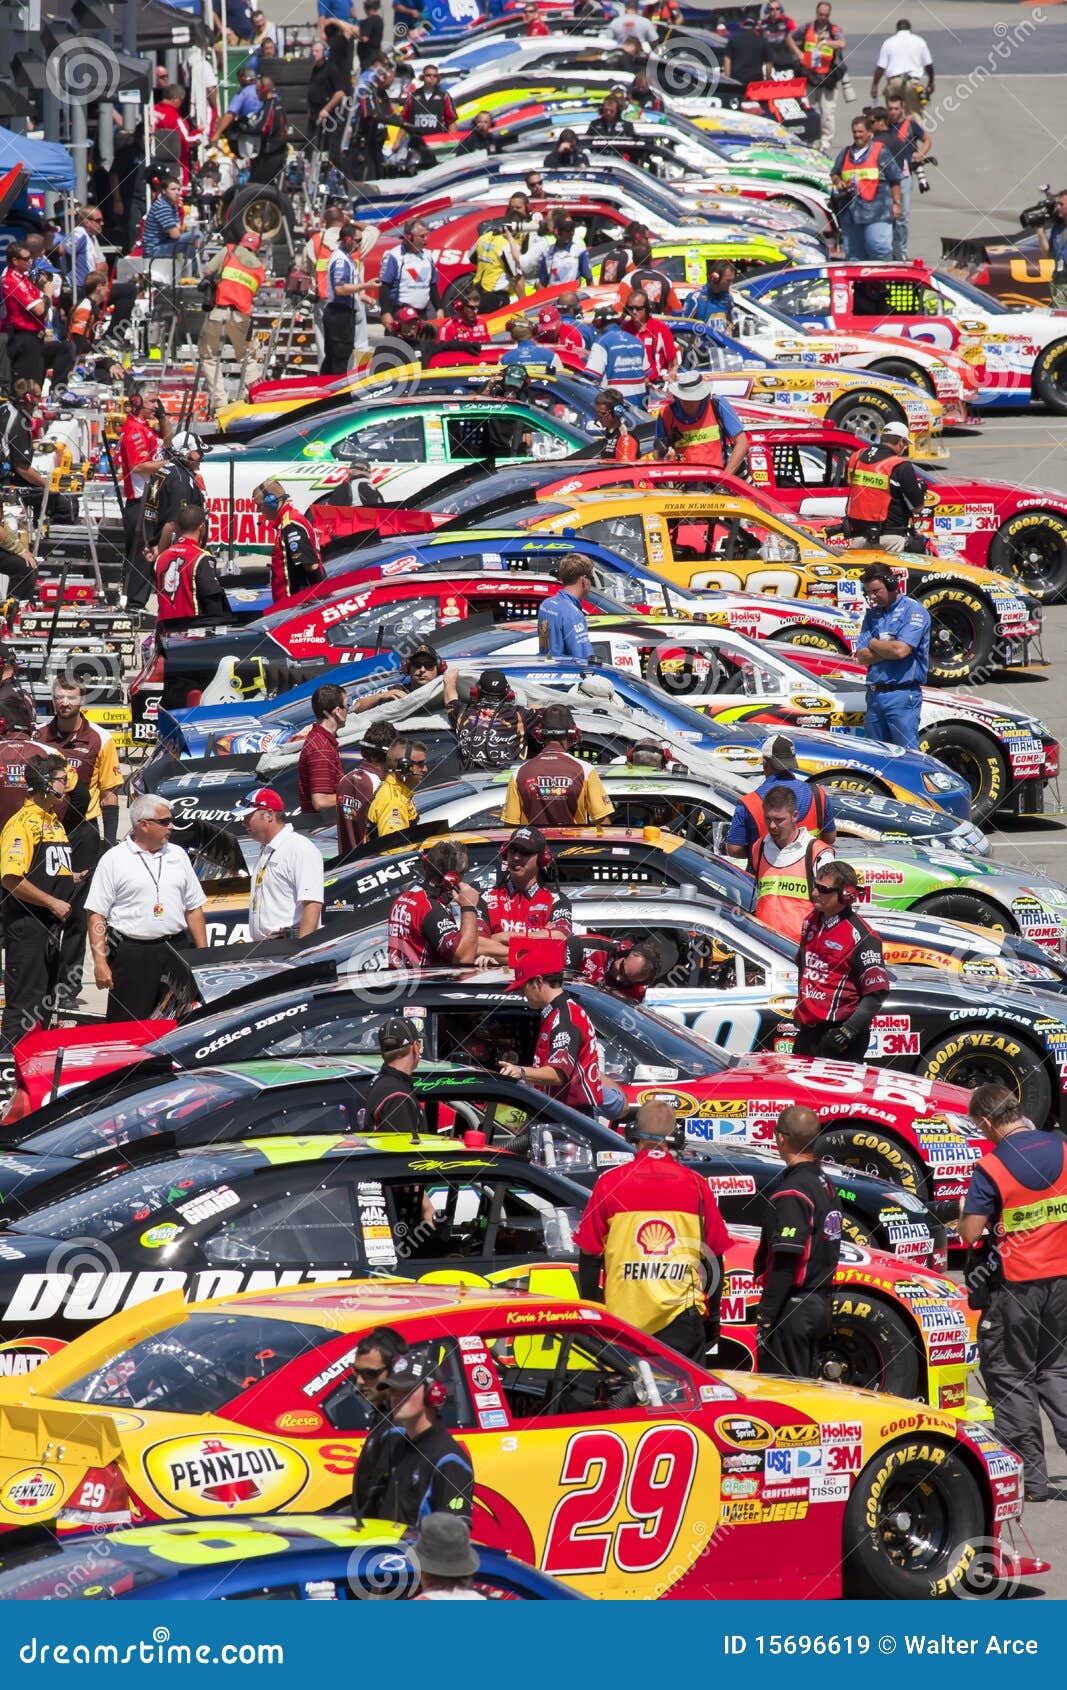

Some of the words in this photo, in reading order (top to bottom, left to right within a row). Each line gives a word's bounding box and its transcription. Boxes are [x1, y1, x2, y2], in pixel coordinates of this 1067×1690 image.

[819, 353, 839, 363] 3M
[811, 393, 831, 403] 3M
[966, 505, 993, 513] Holley
[206, 514, 277, 544] GUAR
[975, 517, 999, 529] 3M
[839, 581, 856, 595] USG
[321, 592, 372, 623] SKF
[997, 600, 1026, 611] MAHLE
[730, 612, 761, 622] Holley
[112, 621, 132, 631] RR
[614, 656, 634, 666] 3M
[1010, 741, 1043, 752] MAHLE
[1015, 754, 1038, 763] COMP
[987, 757, 1002, 800] EAGLE
[46, 845, 72, 876] CAT
[357, 857, 420, 894] SKF
[866, 870, 904, 883] Holley
[778, 882, 807, 894] PHOTO
[1022, 913, 1060, 925] MAHLE
[1027, 928, 1058, 937] COMP
[949, 1007, 1034, 1026] GOODYEAR
[194, 1027, 252, 1060] Office
[255, 1003, 309, 1031] DEPOT
[883, 1034, 918, 1055] 3M
[686, 1119, 714, 1141] USG
[919, 1134, 966, 1144] MOOG
[929, 1149, 981, 1163] MAHLE
[936, 1165, 972, 1177] COMP
[711, 1177, 754, 1193] Holley
[182, 1190, 240, 1225] GUARD
[360, 1207, 387, 1220] MAC
[781, 1227, 796, 1237] 24
[890, 1224, 930, 1241] MAHLE
[897, 1242, 927, 1255] COMP
[507, 1311, 536, 1324] Kevin
[538, 1309, 580, 1323] Harvick
[923, 1312, 965, 1327] MAHLE
[929, 1331, 961, 1344] COMP
[930, 1350, 965, 1362] Edelbrock
[821, 1424, 862, 1441] Holley
[879, 1414, 956, 1437] GOODYEAR
[735, 1430, 757, 1439] Sprint
[501, 1436, 519, 1452] 3
[767, 1450, 791, 1475] USG
[828, 1446, 862, 1471] 3M
[170, 1447, 286, 1491] PENNZOIL
[989, 1457, 1019, 1476] MAHLE
[6, 1480, 57, 1502] PENNZOIL
[762, 1487, 808, 1499] CRAFTSMAN
[810, 1485, 849, 1497] TISSOT
[866, 1444, 946, 1529] GOODYEAR
[79, 1481, 105, 1507] 29
[541, 1424, 698, 1575] 29
[731, 1502, 755, 1512] Auto
[764, 1502, 809, 1522] JEGS
[996, 1504, 1018, 1517] COMP
[730, 1511, 759, 1521] Meter
[936, 1544, 976, 1595] EAGLE
